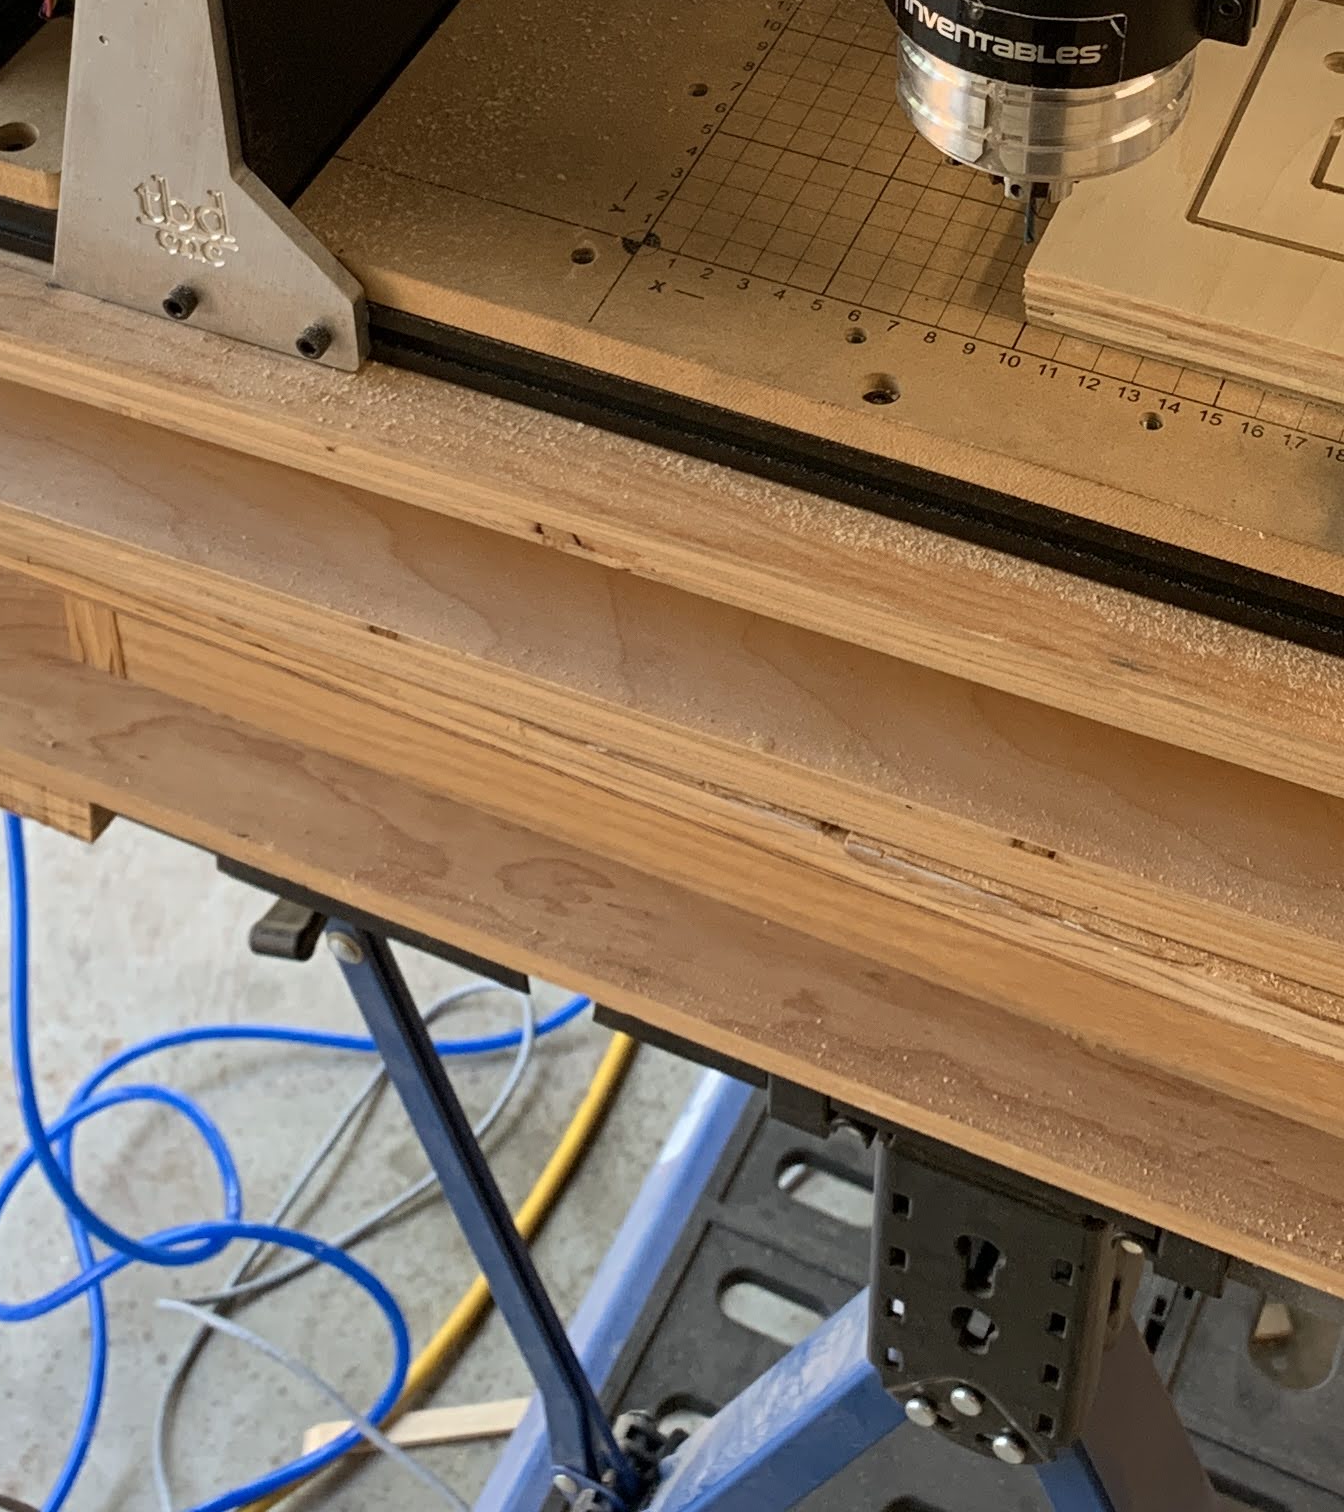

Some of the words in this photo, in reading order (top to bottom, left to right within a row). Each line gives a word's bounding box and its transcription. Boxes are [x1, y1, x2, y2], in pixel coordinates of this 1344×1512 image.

[763, 19, 782, 32] 10
[757, 40, 768, 51] 9
[743, 61, 755, 72] 8
[730, 81, 743, 91] 7
[715, 102, 727, 113] 6
[700, 123, 713, 135] 5
[686, 146, 698, 156] 4
[670, 167, 683, 179] 3
[656, 190, 670, 201] 2
[644, 213, 652, 224] 1
[668, 258, 677, 268] 1
[699, 267, 714, 279] 2
[737, 278, 750, 290] 3
[773, 289, 786, 300] 4
[810, 299, 824, 311] 5
[848, 309, 862, 322] 6
[886, 320, 900, 332] 7
[923, 331, 937, 344] 8
[962, 342, 976, 355] 9
[998, 352, 1021, 368] 10
[1038, 364, 1059, 379] 11
[1077, 374, 1101, 392] 12
[1117, 386, 1141, 403] 13
[1157, 398, 1181, 415] 14
[1199, 410, 1223, 427] 15
[1240, 421, 1265, 438] 16
[1282, 433, 1308, 450] 17
